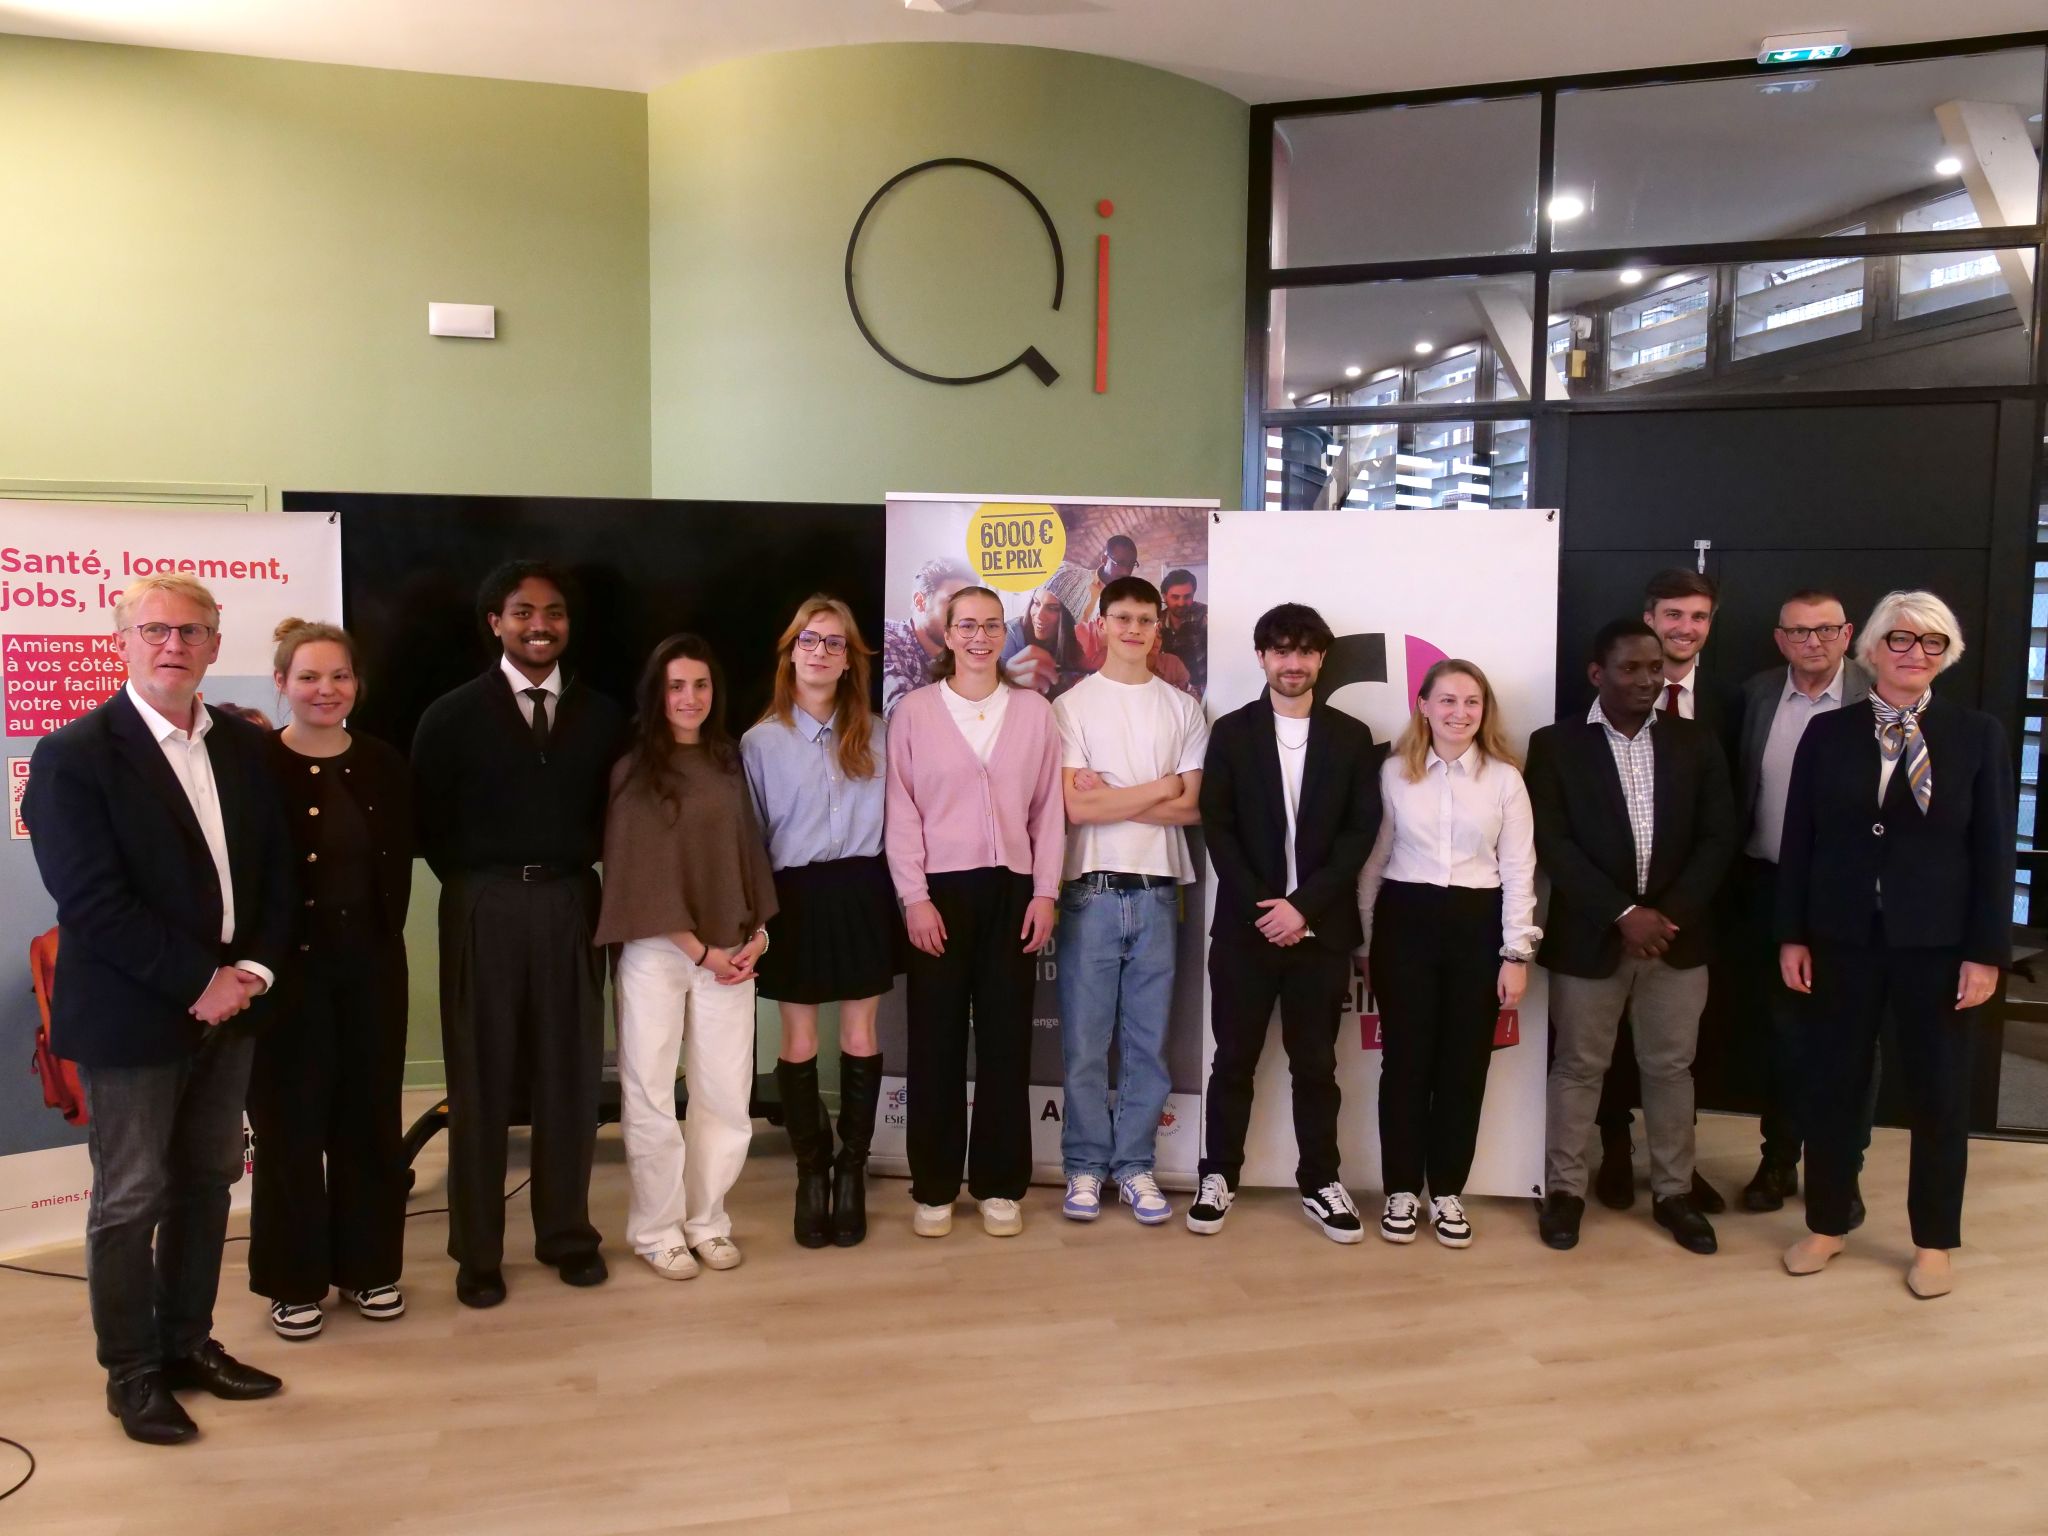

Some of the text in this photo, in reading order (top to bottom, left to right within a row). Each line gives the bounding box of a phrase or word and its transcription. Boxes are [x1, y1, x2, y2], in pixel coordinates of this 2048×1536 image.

[981, 519, 1053, 548] 6000 €
[1, 548, 289, 585] Santé, logement,
[982, 549, 1042, 570] DE PRIX
[1, 581, 86, 613] jobs,
[7, 638, 84, 653] Amiens
[7, 657, 124, 672] à vos côtés
[8, 680, 57, 694] pour
[8, 698, 61, 711] votre
[69, 696, 98, 710] vie
[9, 720, 34, 731] au
